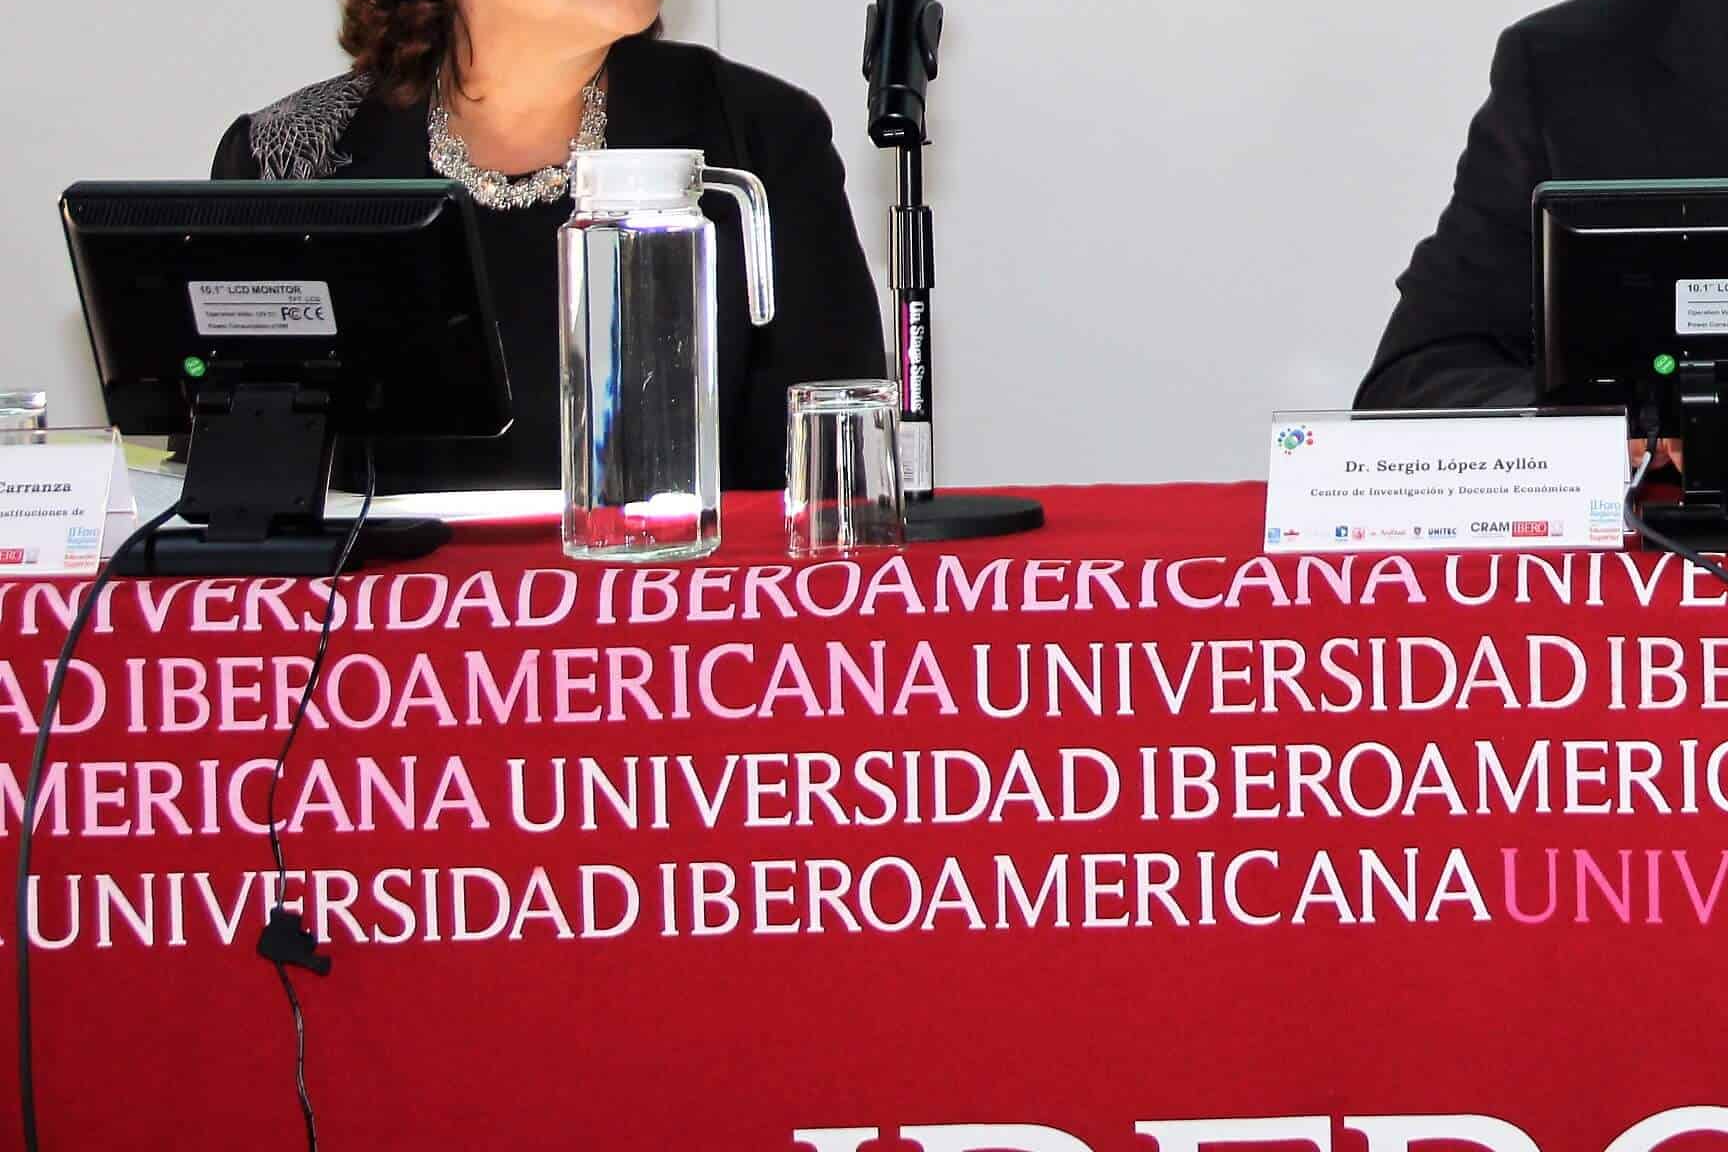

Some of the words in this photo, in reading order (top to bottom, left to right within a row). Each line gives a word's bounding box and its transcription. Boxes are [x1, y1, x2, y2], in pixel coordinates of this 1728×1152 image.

[251, 285, 302, 295] MONITOR
[1345, 460, 1371, 473] Dr.
[1376, 459, 1431, 475] Sergio
[1438, 458, 1487, 474] López
[1493, 457, 1549, 472] Ayllón
[1310, 487, 1349, 497] Centro
[1352, 486, 1366, 496] de
[1369, 486, 1444, 498] Investigación
[1458, 485, 1510, 495] Docencia
[1513, 483, 1582, 494] Económicas
[1470, 521, 1510, 533] CRAM
[1513, 522, 1548, 535] IBERO
[596, 555, 1427, 625] IBEROAMERICANA
[126, 640, 960, 734] IBEROAMERICANA
[973, 635, 1587, 720] UNIVERSIDAD
[507, 749, 1120, 833] UNIVERSIDAD
[28, 865, 640, 950] UNIVERSIDAD
[659, 848, 1492, 937] IBEROAMERICANA
